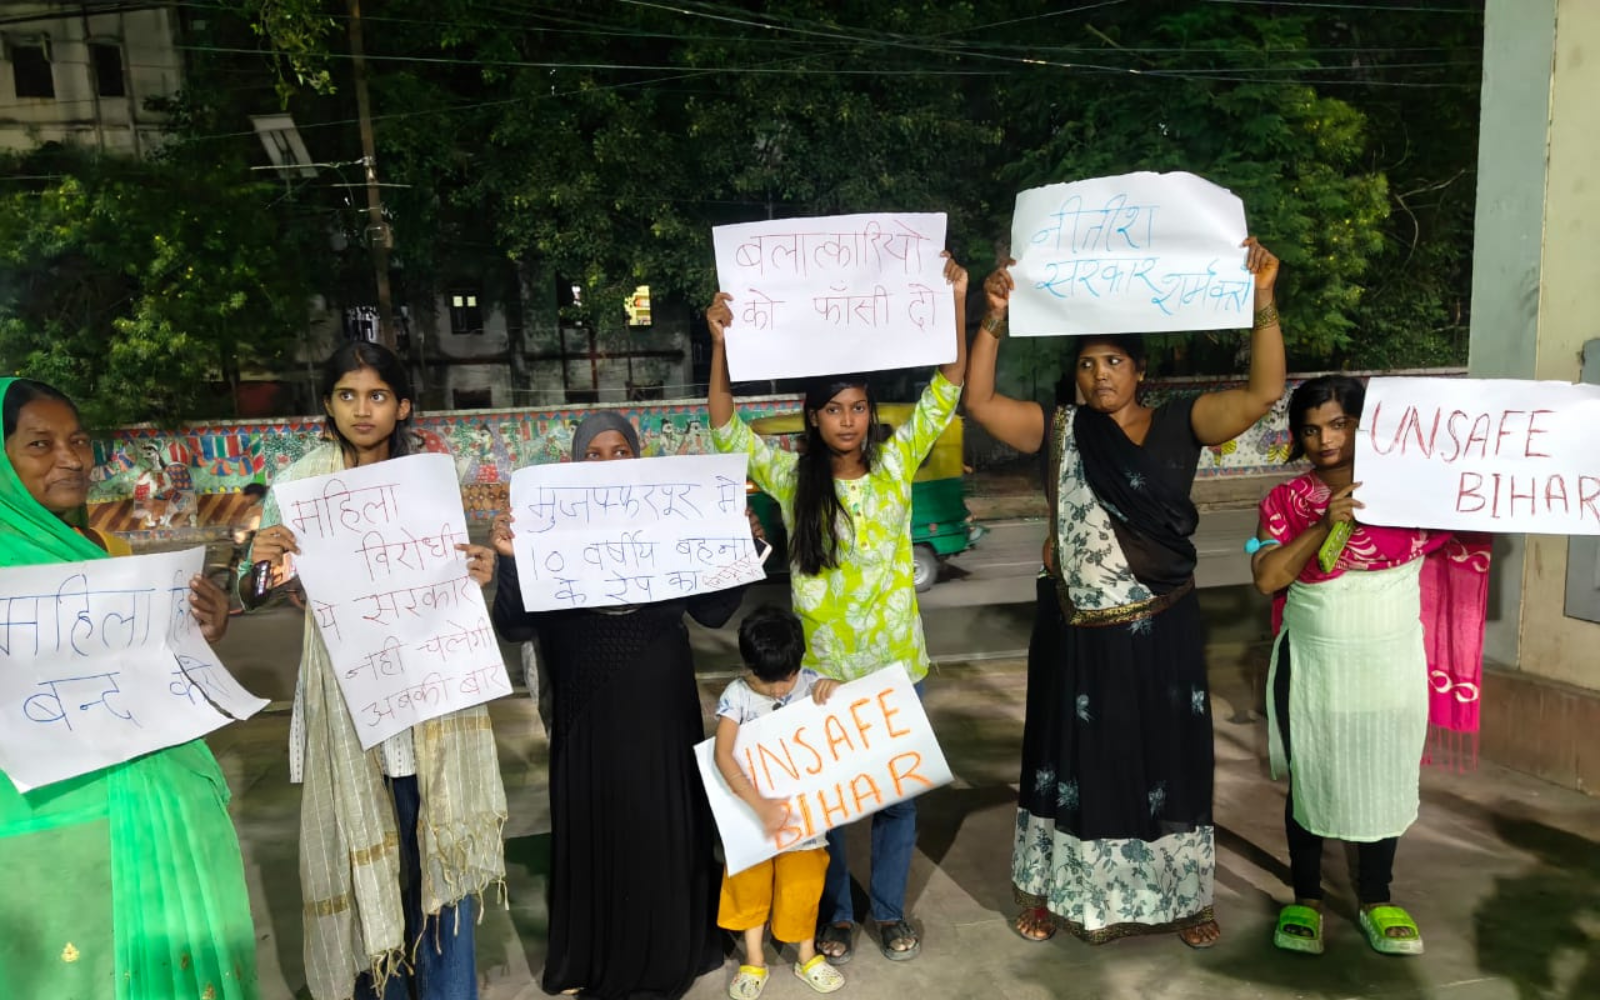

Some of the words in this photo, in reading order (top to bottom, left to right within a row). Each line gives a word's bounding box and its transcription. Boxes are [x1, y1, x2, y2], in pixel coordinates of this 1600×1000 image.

[1035, 257, 1163, 298] सरकार
[743, 288, 786, 331] को
[908, 283, 950, 332] दो
[1371, 400, 1556, 464] UNSAFE
[291, 478, 400, 541] महिला
[1456, 471, 1600, 522] BIHAR
[355, 522, 467, 582] विरोधी
[583, 529, 661, 571] वर्षीय
[0, 574, 156, 656] महिला
[353, 575, 476, 626] सरकार
[553, 576, 587, 605] के
[603, 570, 656, 605] रेप
[664, 570, 703, 592] का
[24, 672, 143, 731] बन्द
[361, 671, 456, 727] अबकी
[460, 663, 512, 695] बार
[774, 751, 934, 850] BIHAR
